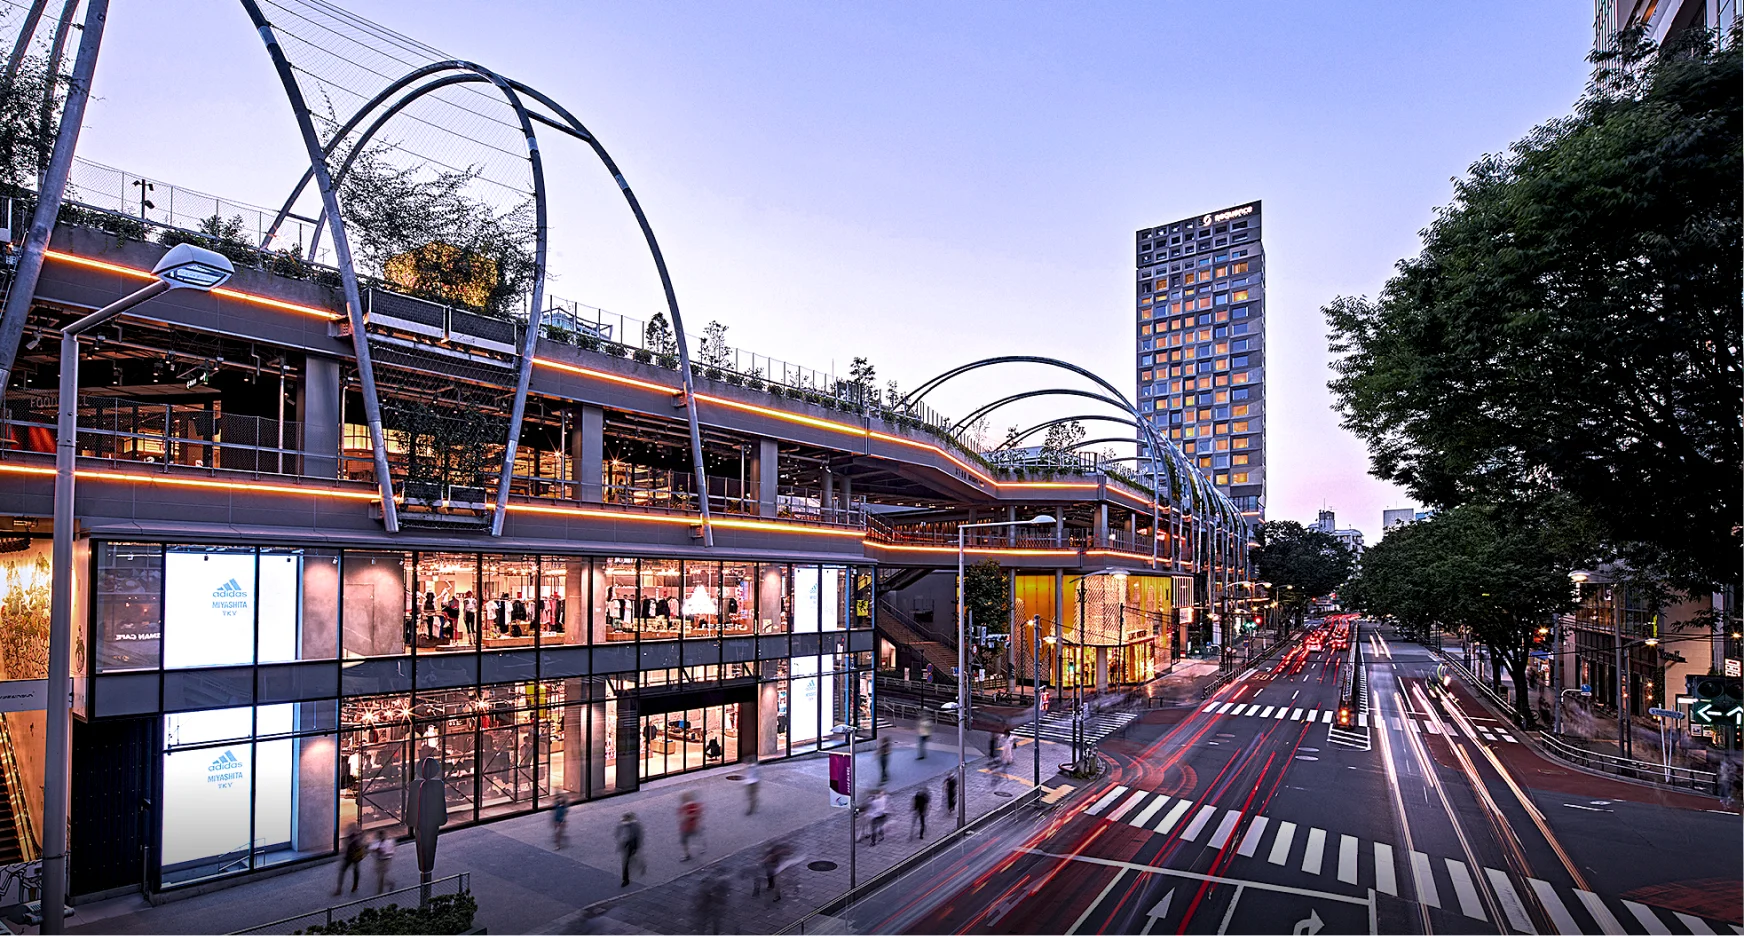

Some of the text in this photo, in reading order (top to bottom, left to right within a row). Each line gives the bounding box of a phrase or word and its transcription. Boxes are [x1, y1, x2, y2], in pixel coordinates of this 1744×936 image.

[212, 590, 248, 598] adidas
[212, 601, 248, 609] MIYASHITA
[208, 762, 243, 772] adidas
[207, 772, 243, 782] MIYASHITA
